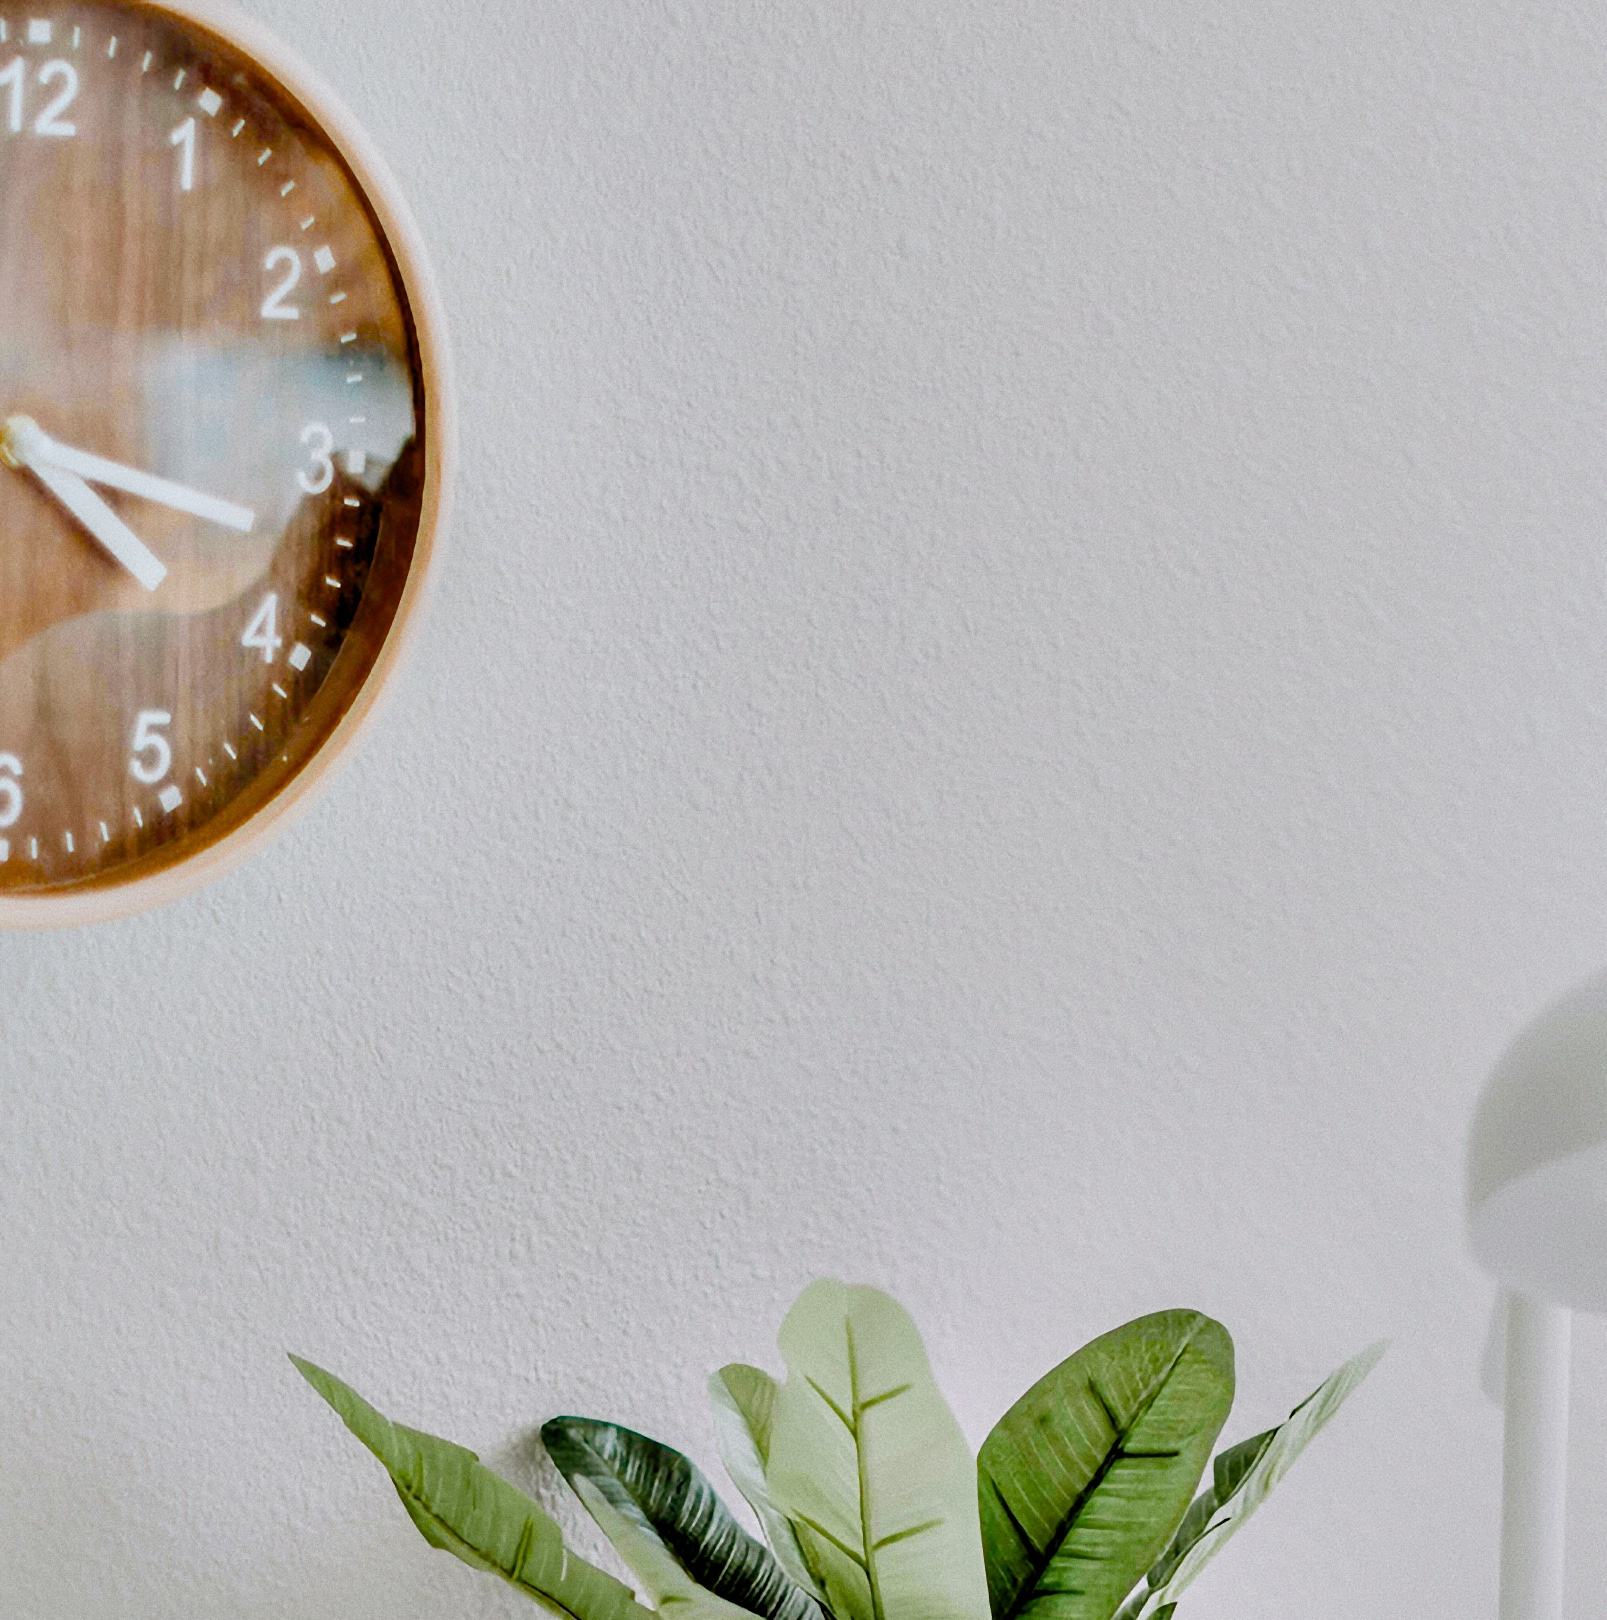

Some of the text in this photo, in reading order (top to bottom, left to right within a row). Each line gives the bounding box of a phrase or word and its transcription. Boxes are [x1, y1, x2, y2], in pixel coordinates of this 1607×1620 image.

[0, 55, 77, 137] 12
[170, 116, 195, 191] 1
[260, 246, 301, 320] 2
[296, 422, 334, 494] 3
[241, 593, 282, 664] 4
[130, 709, 172, 784] 5
